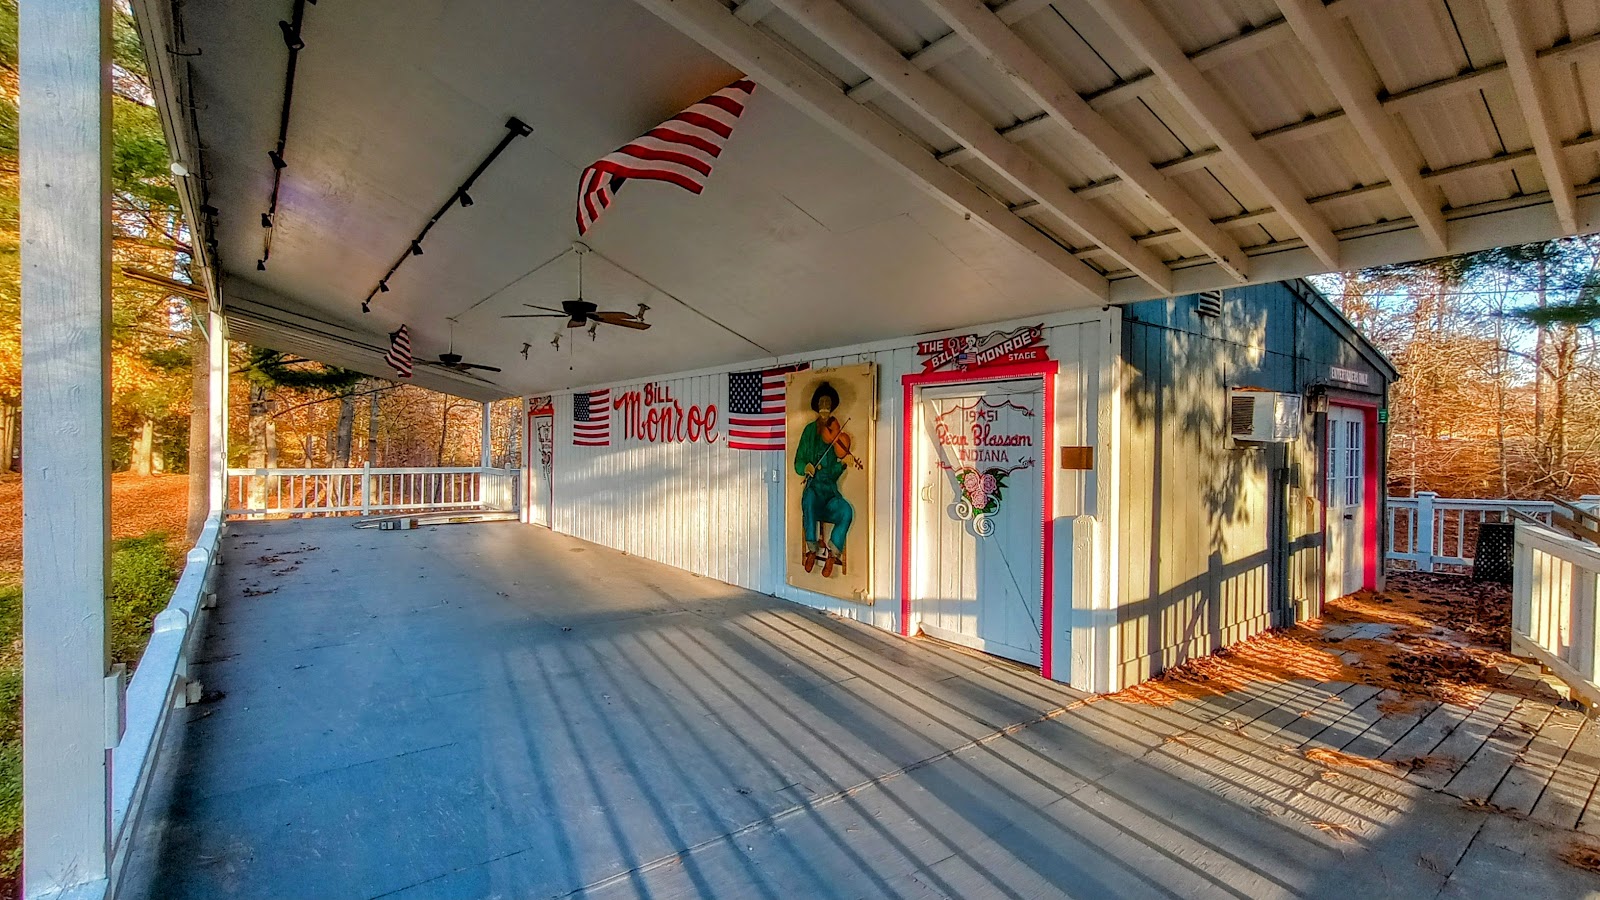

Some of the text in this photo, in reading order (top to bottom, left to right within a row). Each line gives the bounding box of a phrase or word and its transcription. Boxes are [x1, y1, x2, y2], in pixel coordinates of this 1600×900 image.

[921, 340, 944, 353] THE
[931, 331, 1032, 368] BILL MONROE
[1008, 351, 1037, 361] STAGE
[613, 391, 720, 443] Monroe
[935, 423, 1033, 446] Bean Blossom
[960, 450, 1009, 462] INDIANA
